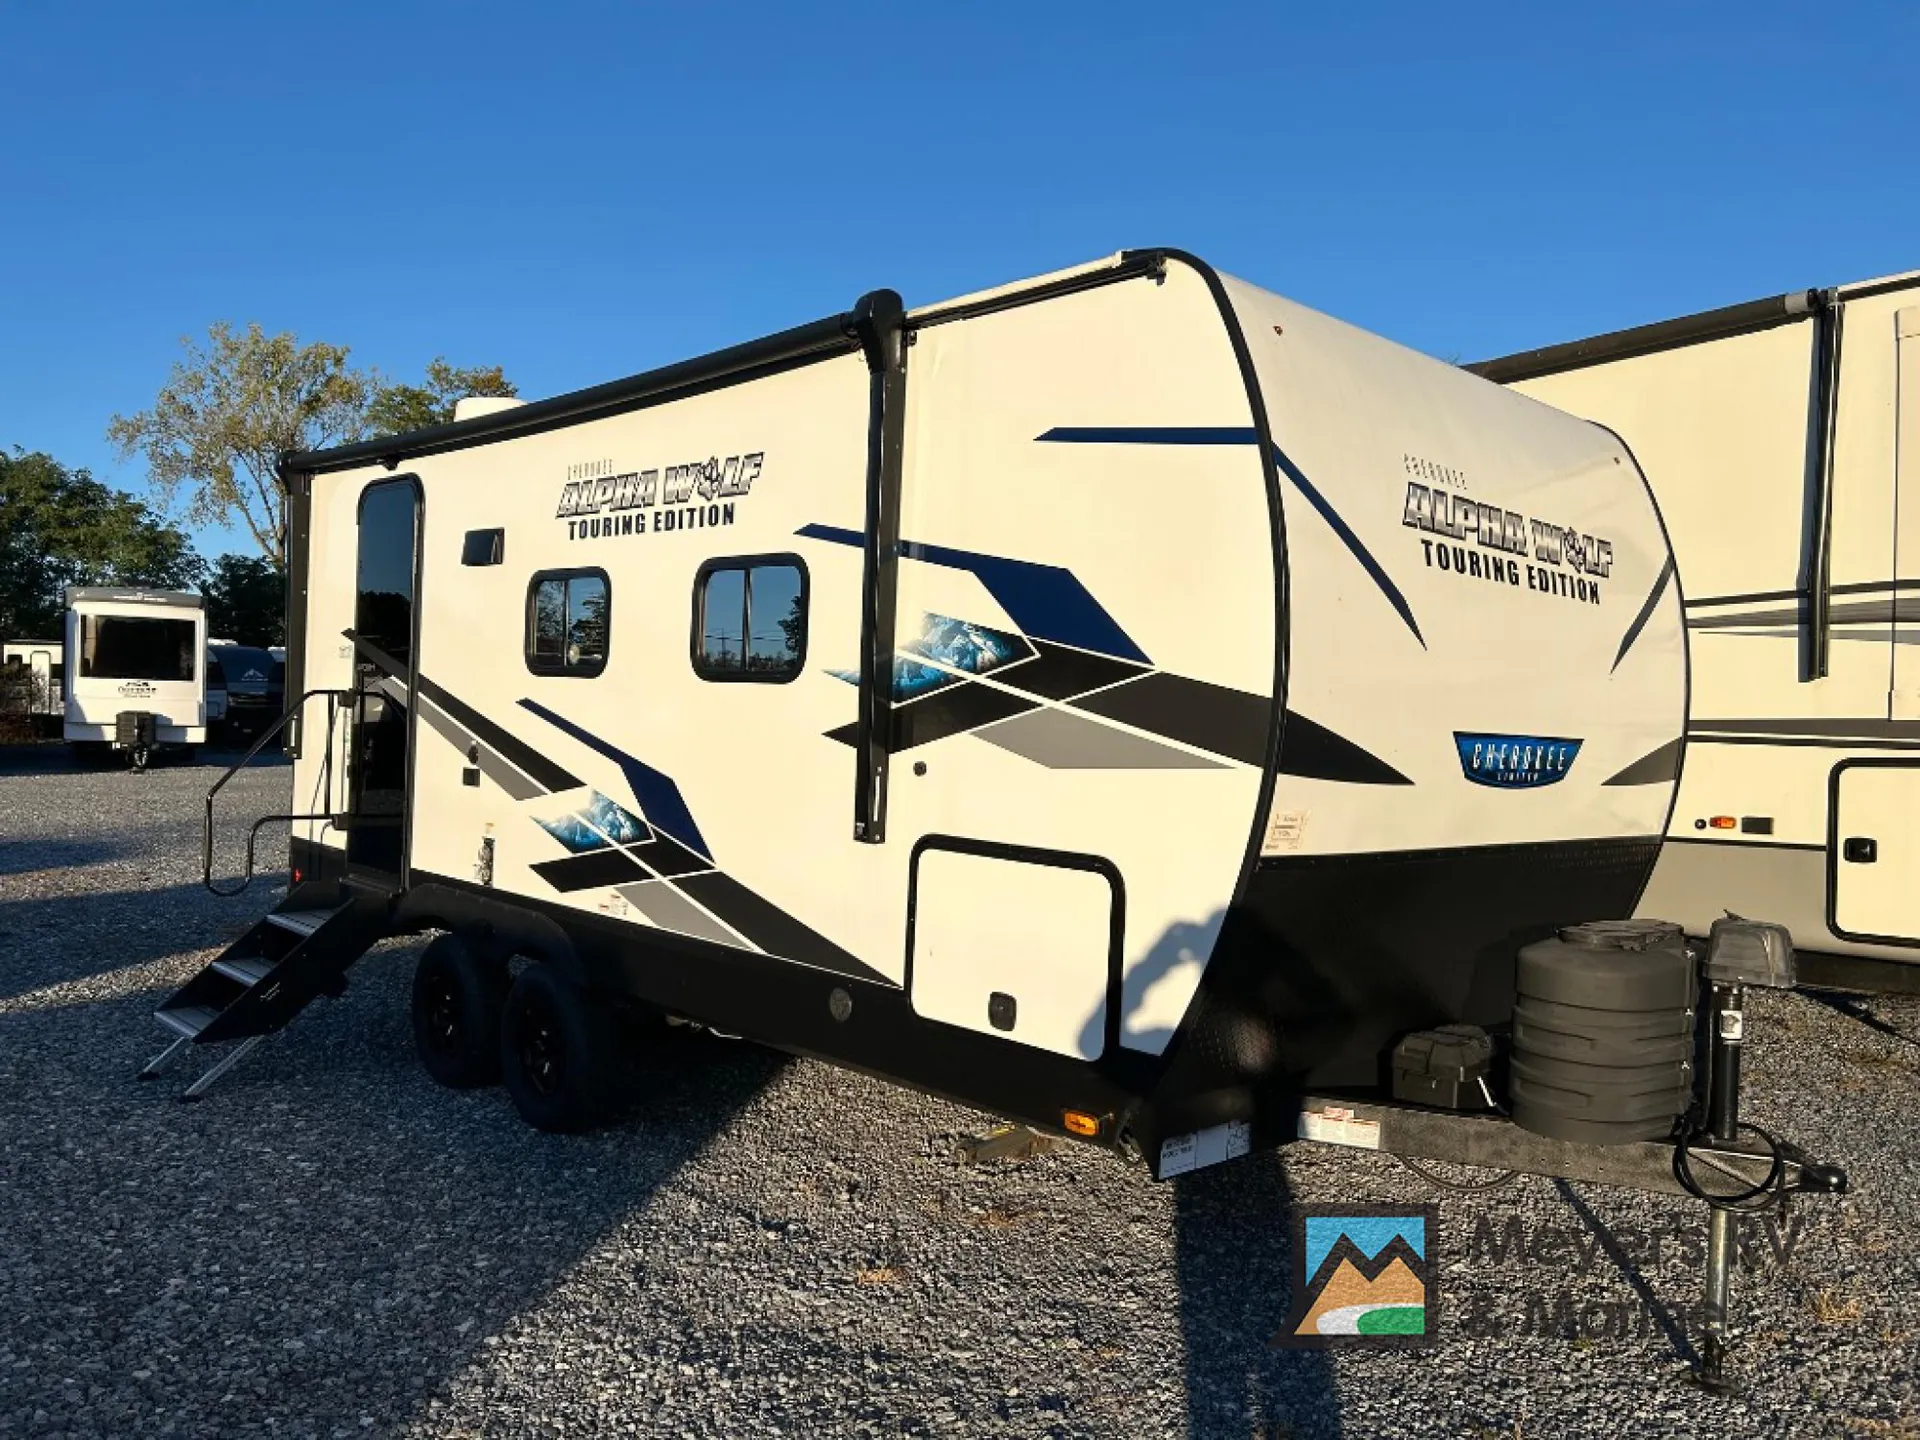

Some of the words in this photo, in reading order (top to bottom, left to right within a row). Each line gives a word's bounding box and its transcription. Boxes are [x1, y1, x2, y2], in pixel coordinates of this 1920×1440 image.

[555, 469, 658, 519] ALPHA
[1402, 481, 1528, 557] ALPHA
[568, 512, 645, 540] TOURING
[653, 502, 735, 532] EDITION
[1421, 538, 1520, 586] TOURING
[1526, 564, 1600, 605] EDITION
[1473, 743, 1566, 772] CHEROKEE
